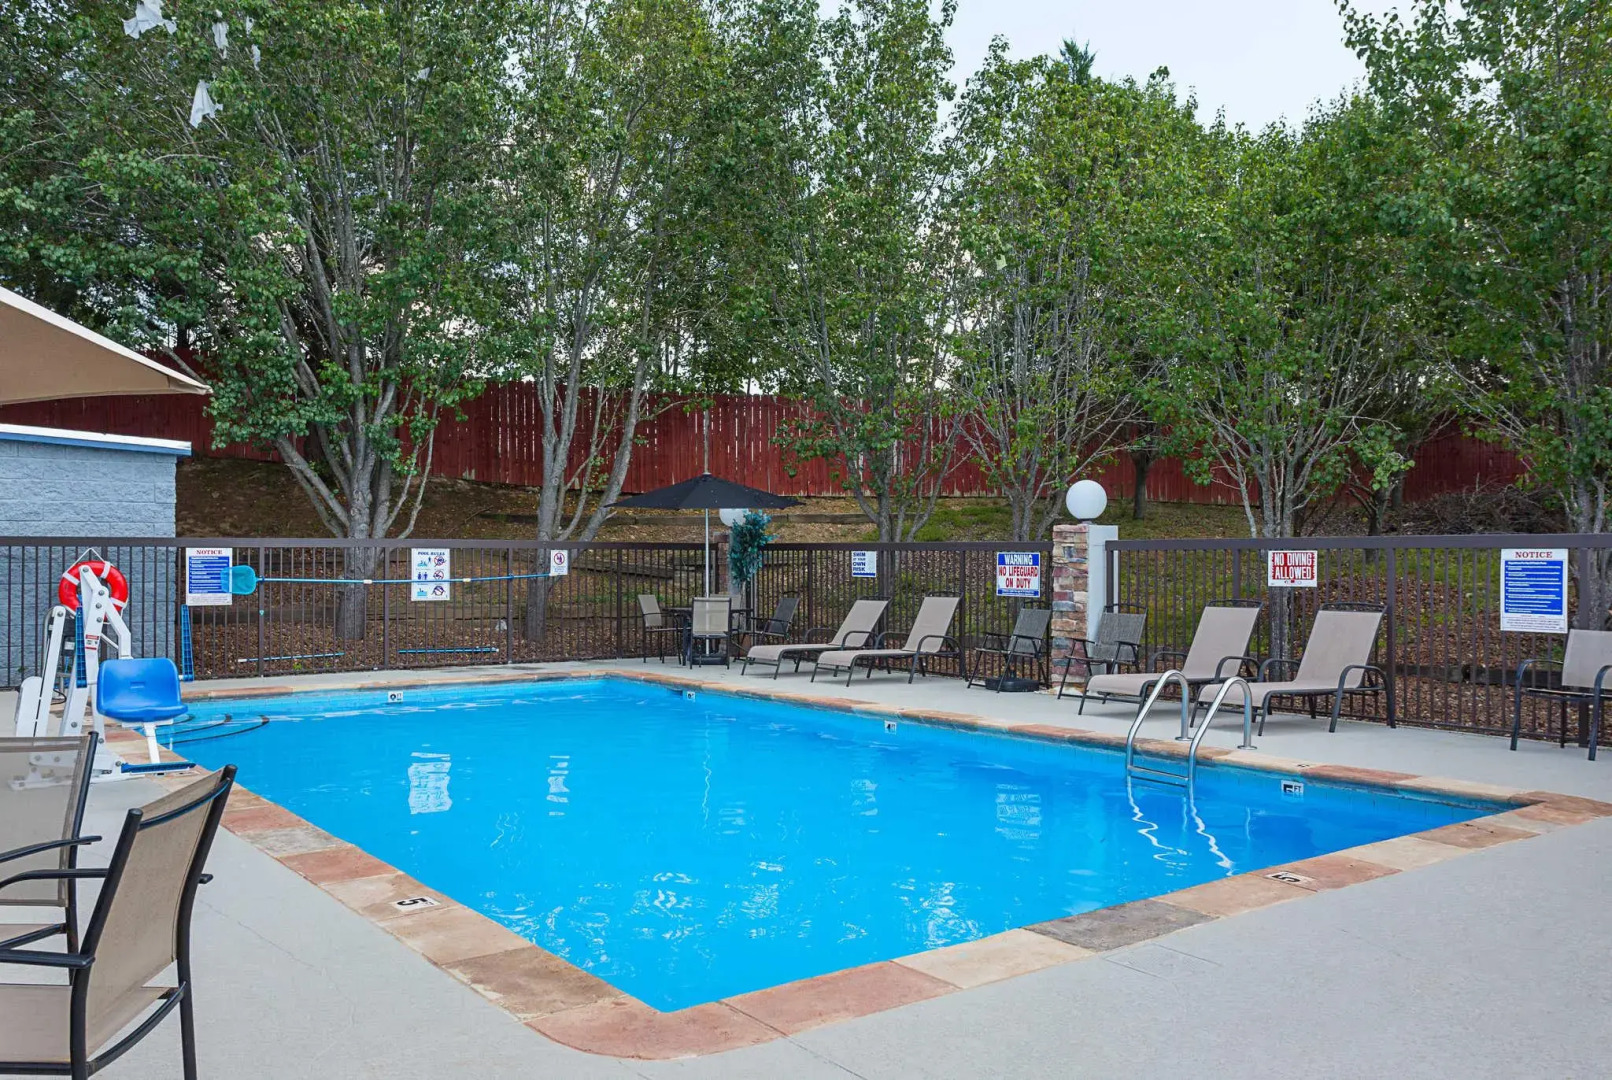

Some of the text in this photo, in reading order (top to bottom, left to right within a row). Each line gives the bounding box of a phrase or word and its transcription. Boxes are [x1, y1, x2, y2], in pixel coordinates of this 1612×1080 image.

[1005, 554, 1032, 565] WARNING
[1275, 553, 1312, 566] NO DIVING
[999, 566, 1038, 577] NO LIFEGUARD
[1275, 566, 1311, 579] ALLOWED
[1006, 578, 1031, 588] ON DUTY
